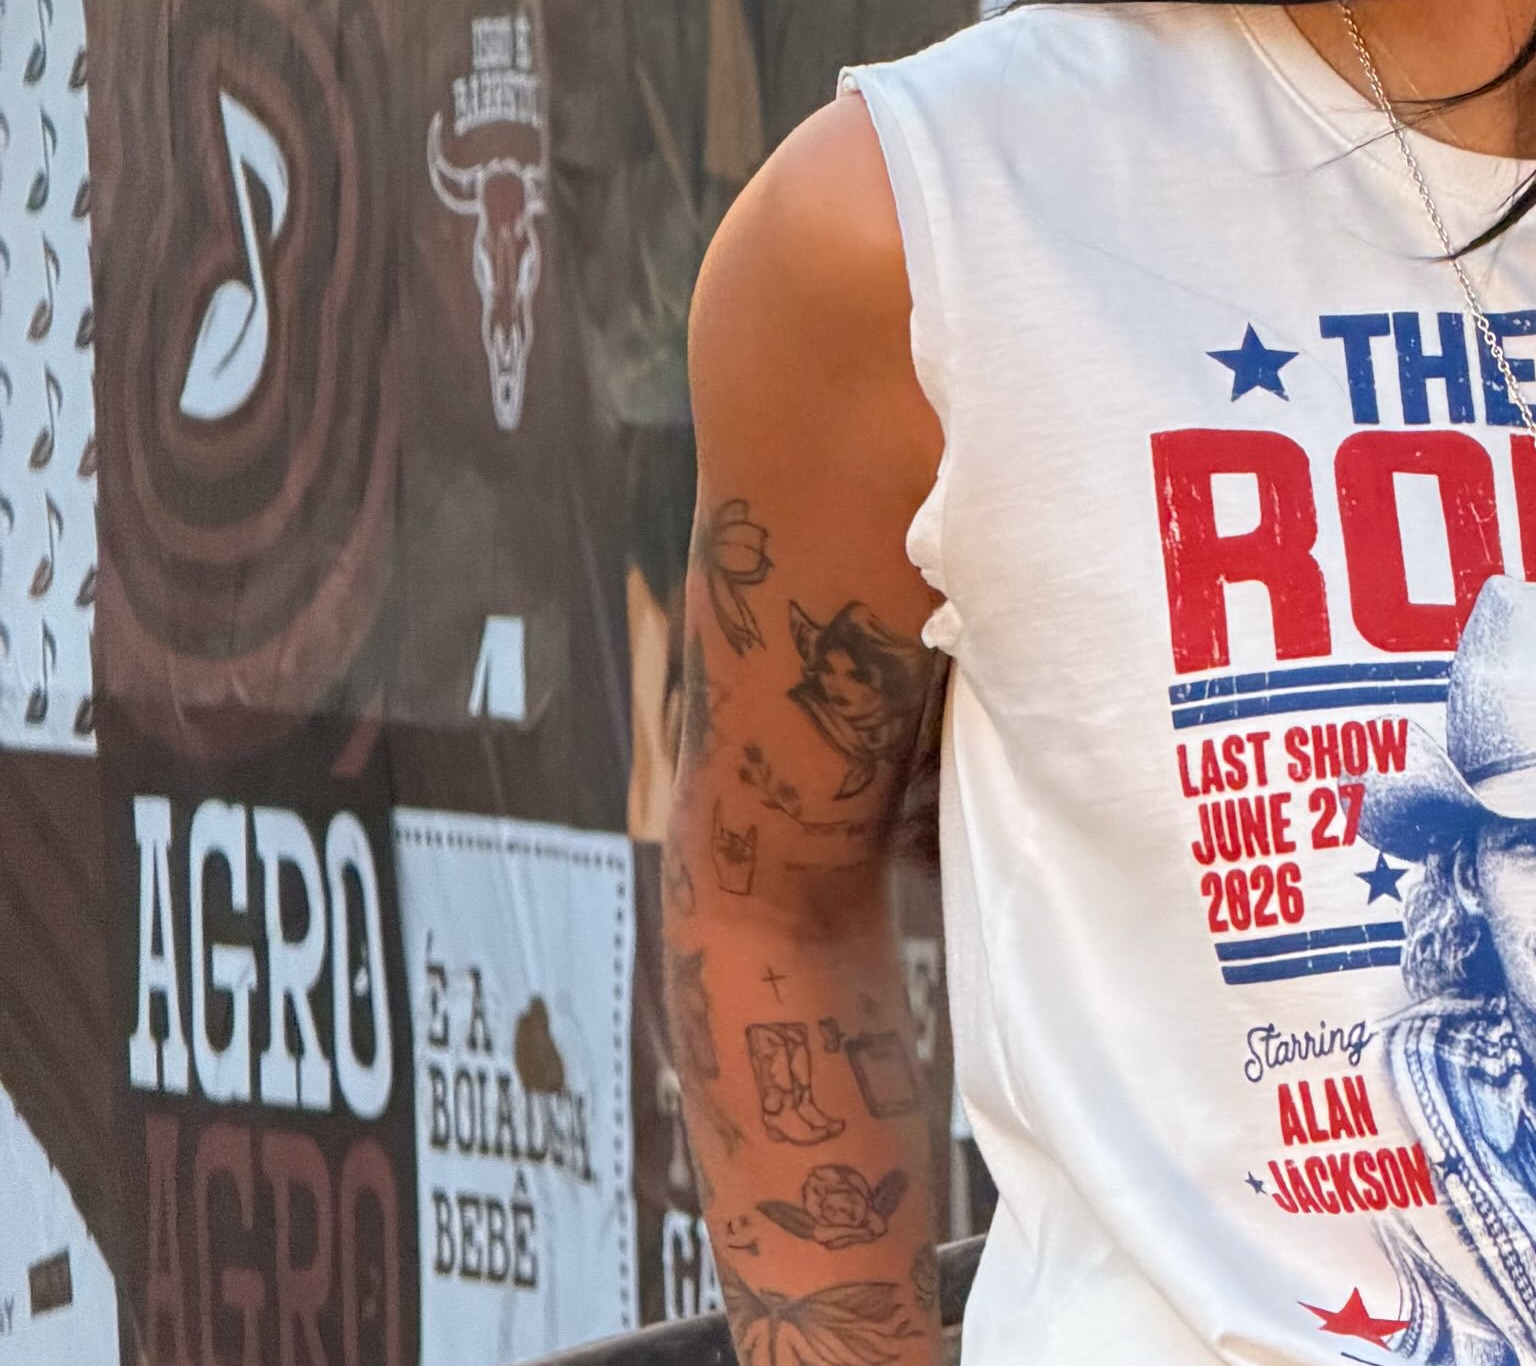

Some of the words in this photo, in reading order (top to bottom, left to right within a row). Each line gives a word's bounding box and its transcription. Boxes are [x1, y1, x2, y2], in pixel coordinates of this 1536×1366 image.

[1176, 731, 1271, 798] LAST
[1284, 718, 1409, 782] SHOW
[1191, 792, 1296, 865] JUNE
[1308, 783, 1366, 850] 27
[1200, 862, 1305, 933] 2026
[129, 795, 393, 1121] AGRO
[466, 964, 494, 1055] A
[1245, 1020, 1379, 1082] Starring
[1278, 1075, 1378, 1146] ALAN
[1267, 1142, 1437, 1214] JACKSON
[432, 1167, 538, 1289] BEBÊ
